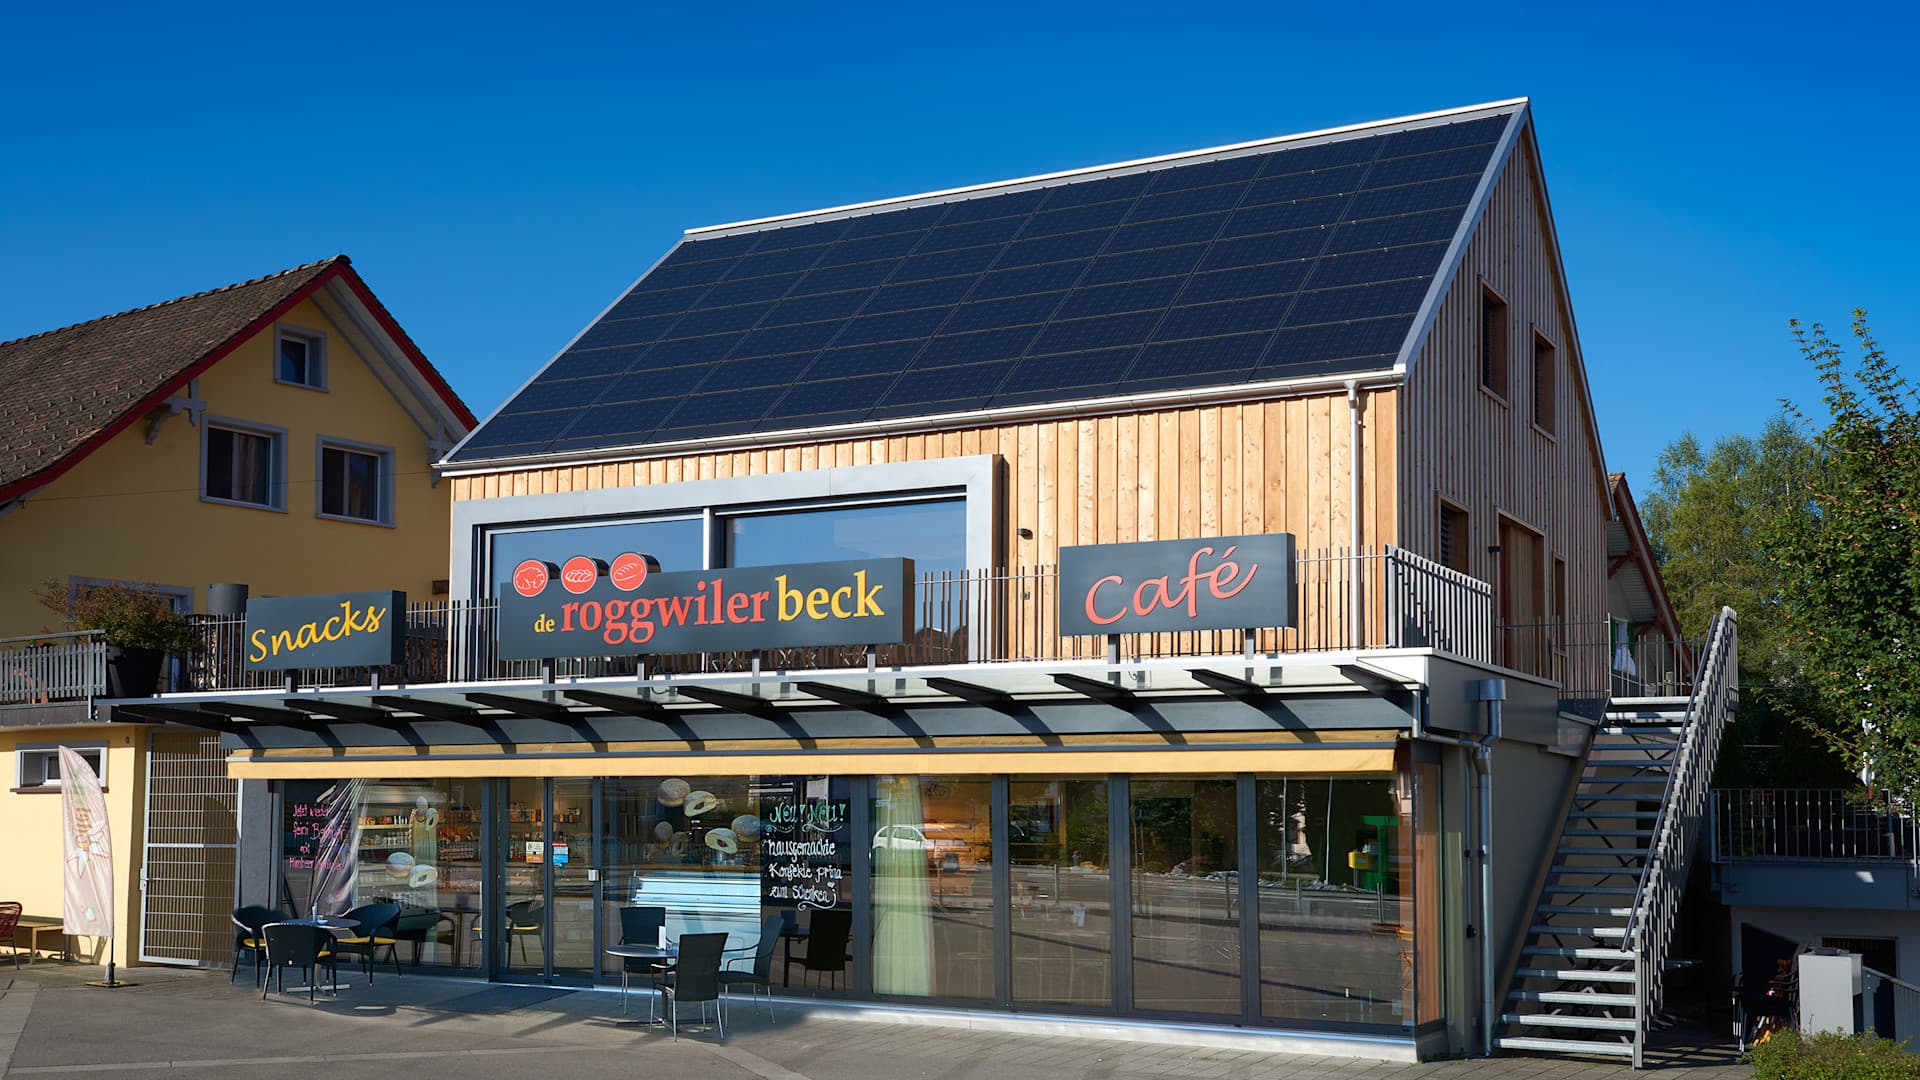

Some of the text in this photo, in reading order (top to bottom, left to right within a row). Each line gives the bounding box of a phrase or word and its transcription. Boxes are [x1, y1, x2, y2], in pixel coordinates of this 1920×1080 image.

[534, 570, 885, 645] de roggwiler beck
[1085, 546, 1258, 625] Café
[249, 601, 386, 663] Snacks
[767, 839, 836, 863] hausgemachte
